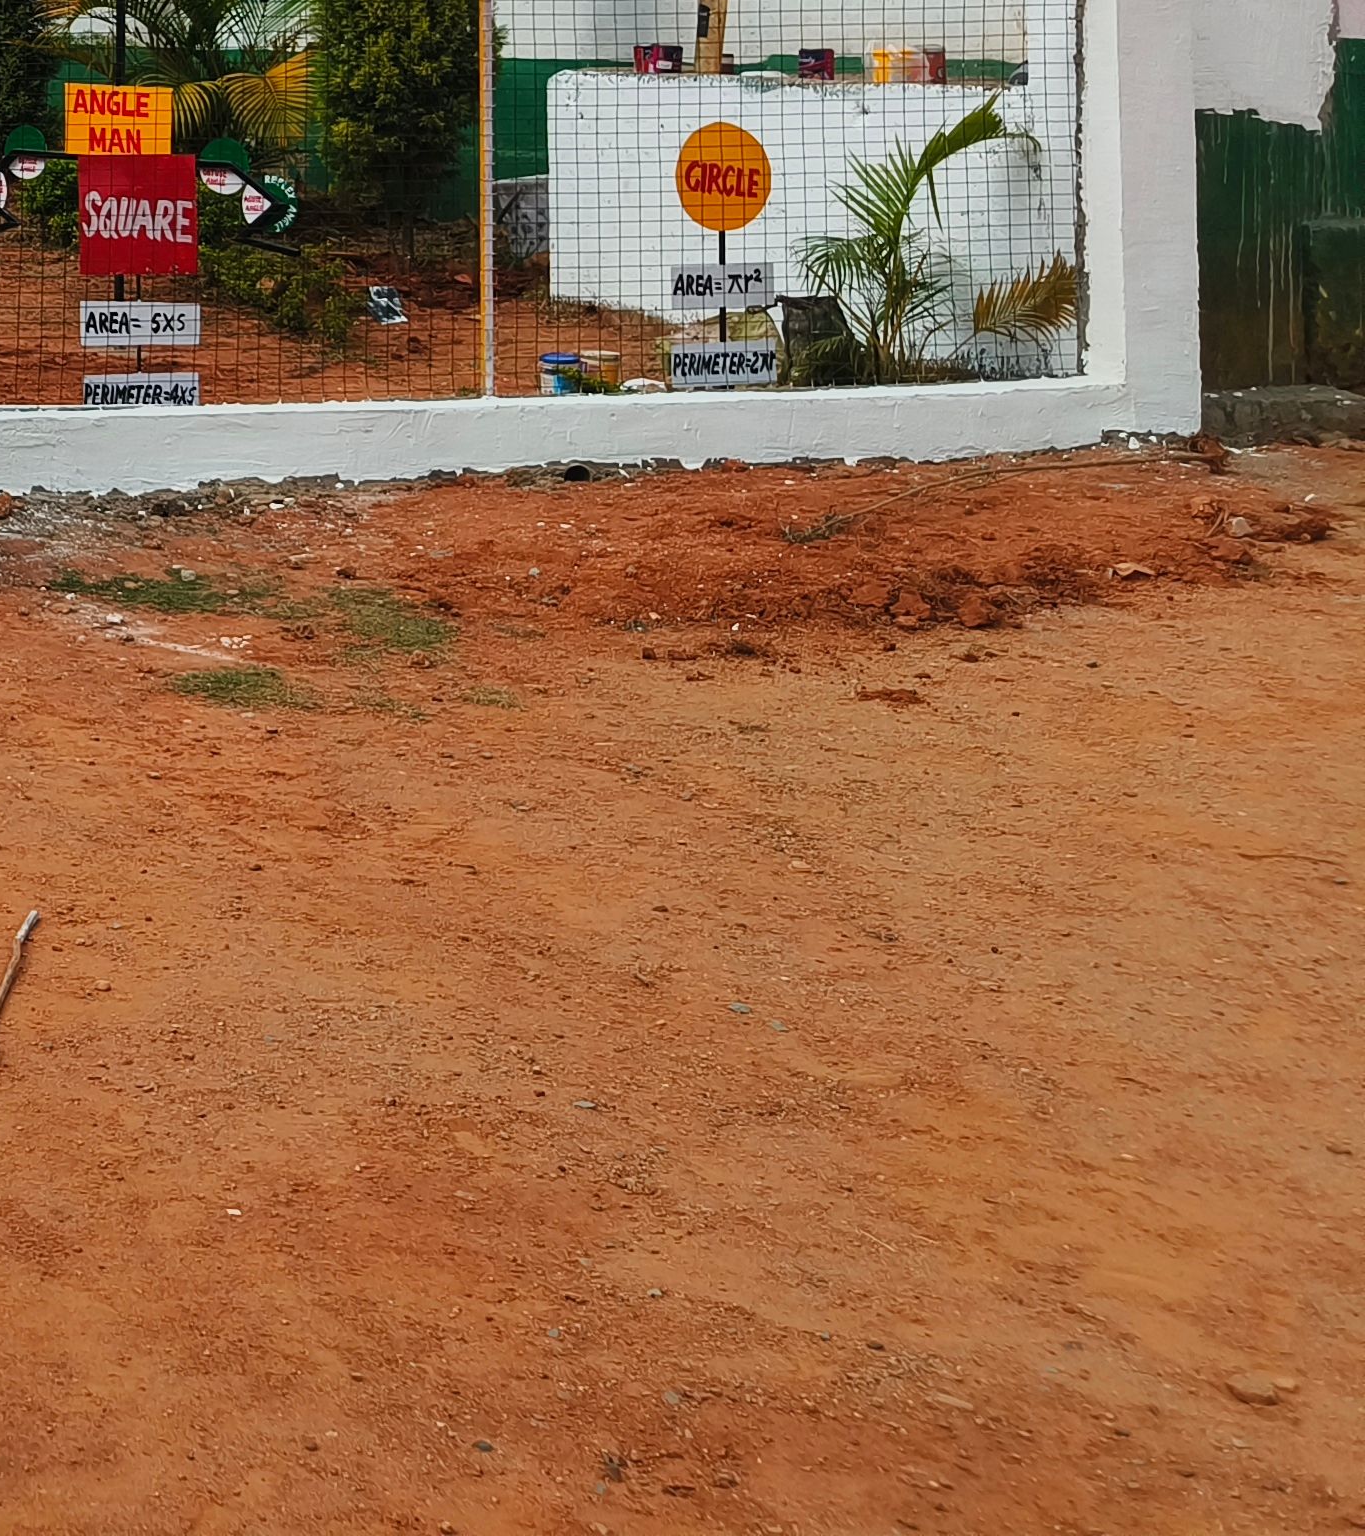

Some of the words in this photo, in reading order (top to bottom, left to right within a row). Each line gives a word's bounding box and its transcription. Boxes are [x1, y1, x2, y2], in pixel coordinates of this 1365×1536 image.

[72, 89, 150, 118] ANGLE
[89, 127, 142, 154] MAN
[684, 160, 761, 198] CIRCLE
[82, 190, 194, 244] SQUARE
